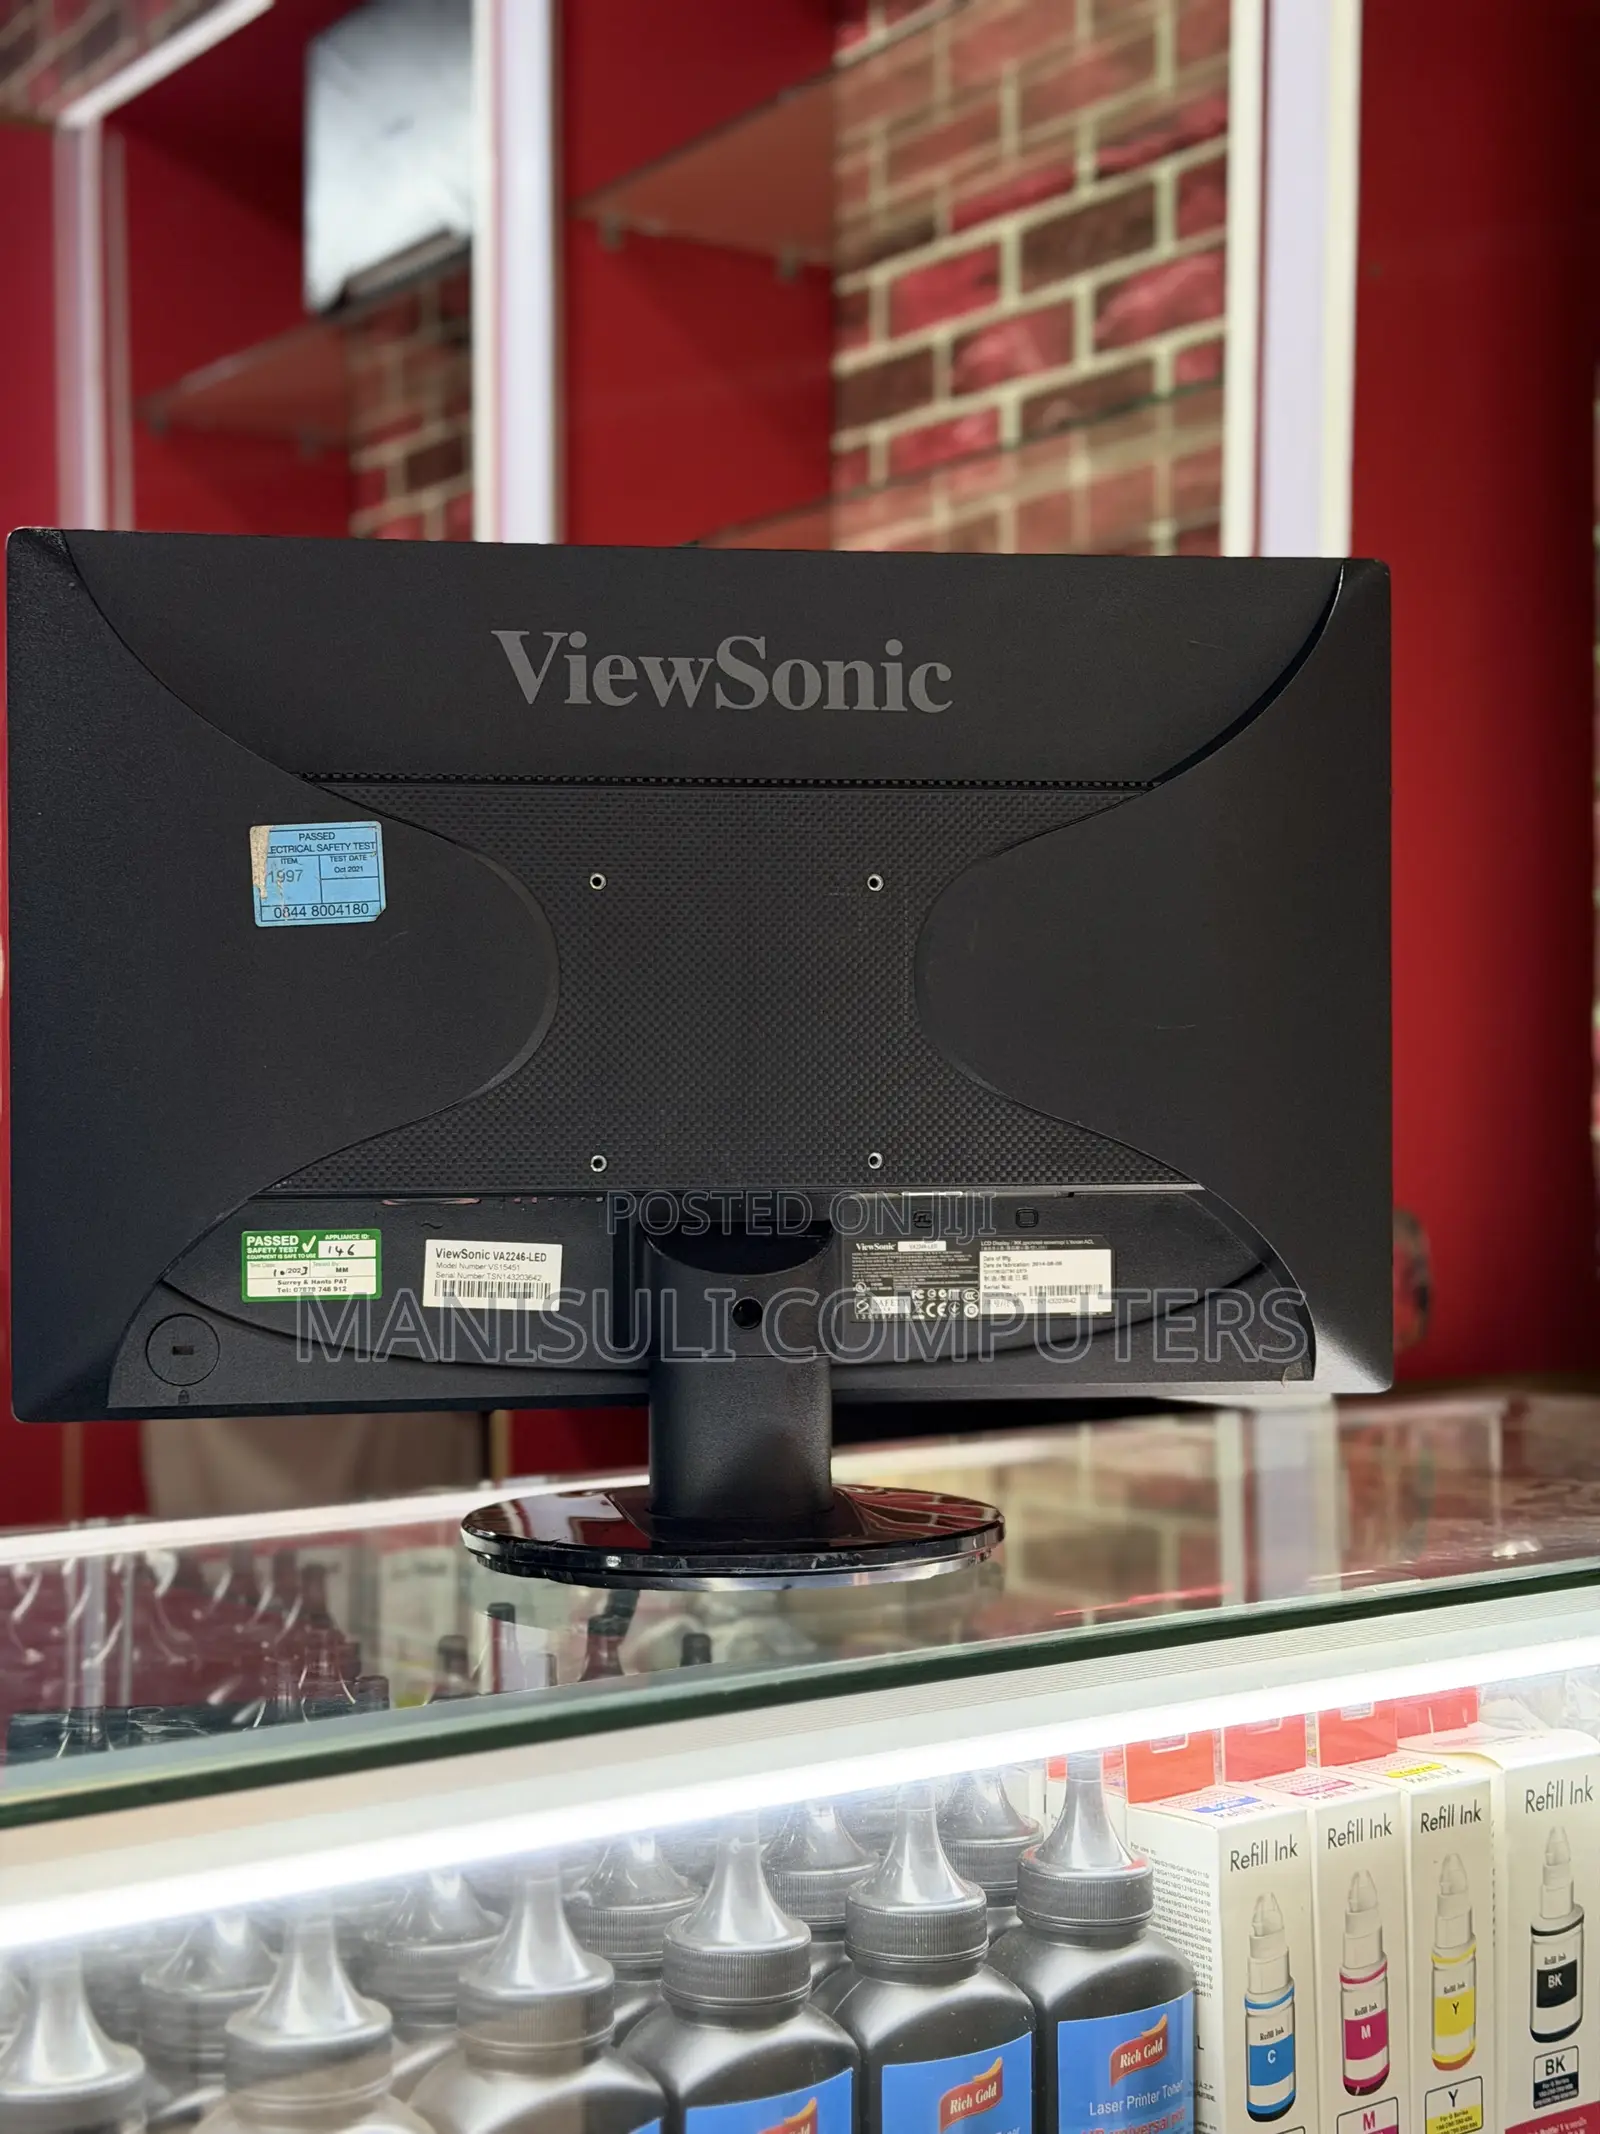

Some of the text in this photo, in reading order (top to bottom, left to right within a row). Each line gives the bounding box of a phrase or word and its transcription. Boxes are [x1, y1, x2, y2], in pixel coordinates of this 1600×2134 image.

[491, 630, 954, 714] ViewSonic
[298, 832, 336, 841] PASSED
[316, 842, 351, 853] SAFETY
[353, 841, 376, 851] TEST
[274, 903, 369, 919] 0844 8004180
[246, 1235, 299, 1247] PASSED
[856, 1243, 896, 1251] ViewSonic
[436, 1248, 547, 1262] ViewSonic VA2246-LED
[459, 1262, 486, 1270] Number
[488, 1263, 520, 1271] VS15451
[436, 1271, 455, 1279] Serial
[457, 1272, 485, 1280] Number
[1525, 1774, 1594, 1814] Refill Ink
[1420, 1800, 1482, 1833] Refill Ink
[1327, 1813, 1392, 1849] Refill Ink
[1230, 1834, 1298, 1872] Refill Ink
[1547, 1973, 1563, 1988] BK
[1452, 2002, 1460, 2015] Y
[1361, 2024, 1371, 2040] M
[1120, 2037, 1163, 2069] Rich Gold
[1267, 2049, 1277, 2064] C
[1545, 2055, 1566, 2077] BK
[950, 2083, 997, 2114] Rich Gold
[1089, 2100, 1124, 2116] Laser
[1126, 2090, 1160, 2110] Printer
[1162, 2079, 1183, 2099] Toner
[1448, 2089, 1459, 2108] Y
[1363, 2110, 1376, 2131] M
